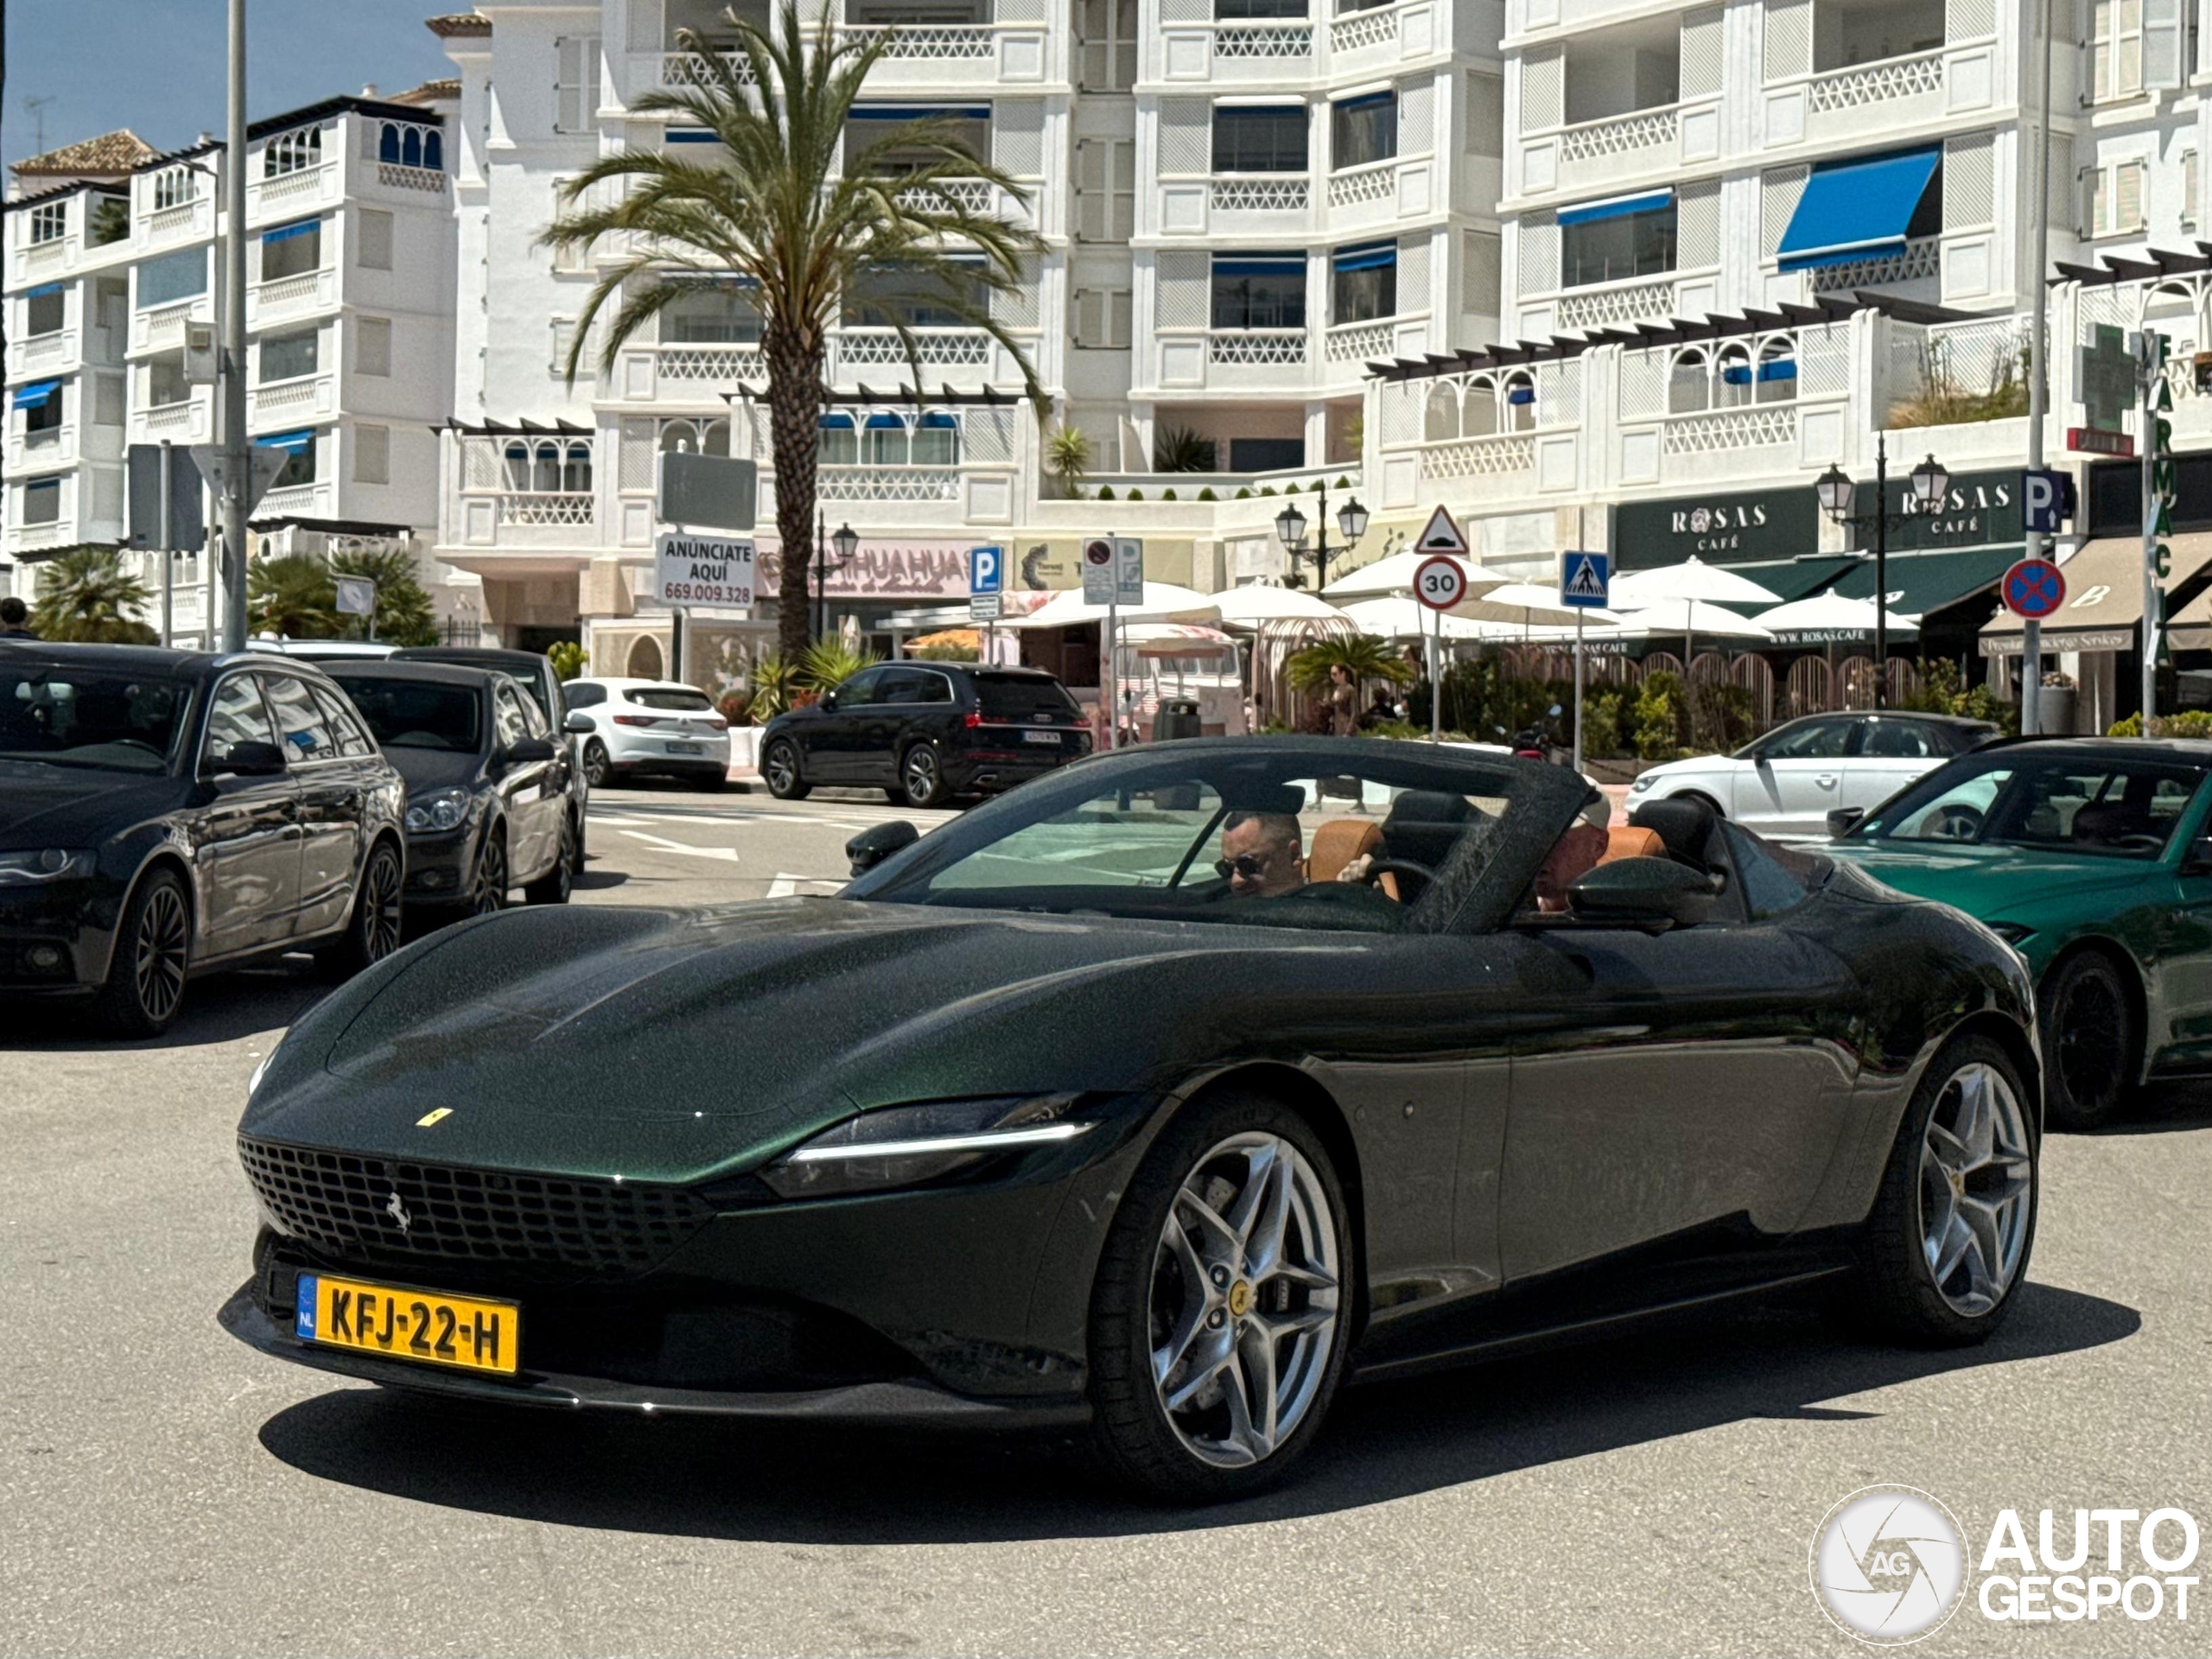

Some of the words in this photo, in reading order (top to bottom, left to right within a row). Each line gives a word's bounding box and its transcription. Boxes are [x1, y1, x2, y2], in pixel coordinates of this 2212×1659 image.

[2026, 476, 2052, 526] P
[2150, 334, 2176, 667] FARMACIA
[1931, 516, 1978, 534] CAFÉ
[665, 537, 751, 563] ANÚNCIATE
[1697, 534, 1738, 551] CAFÉ
[690, 562, 728, 582] AQUÍ
[976, 552, 995, 588] P
[664, 582, 750, 603] 669.009.328
[1426, 575, 1455, 593] 30
[2069, 585, 2111, 607] B
[300, 1311, 315, 1328] NL
[331, 1288, 499, 1362] KFJ-22-H
